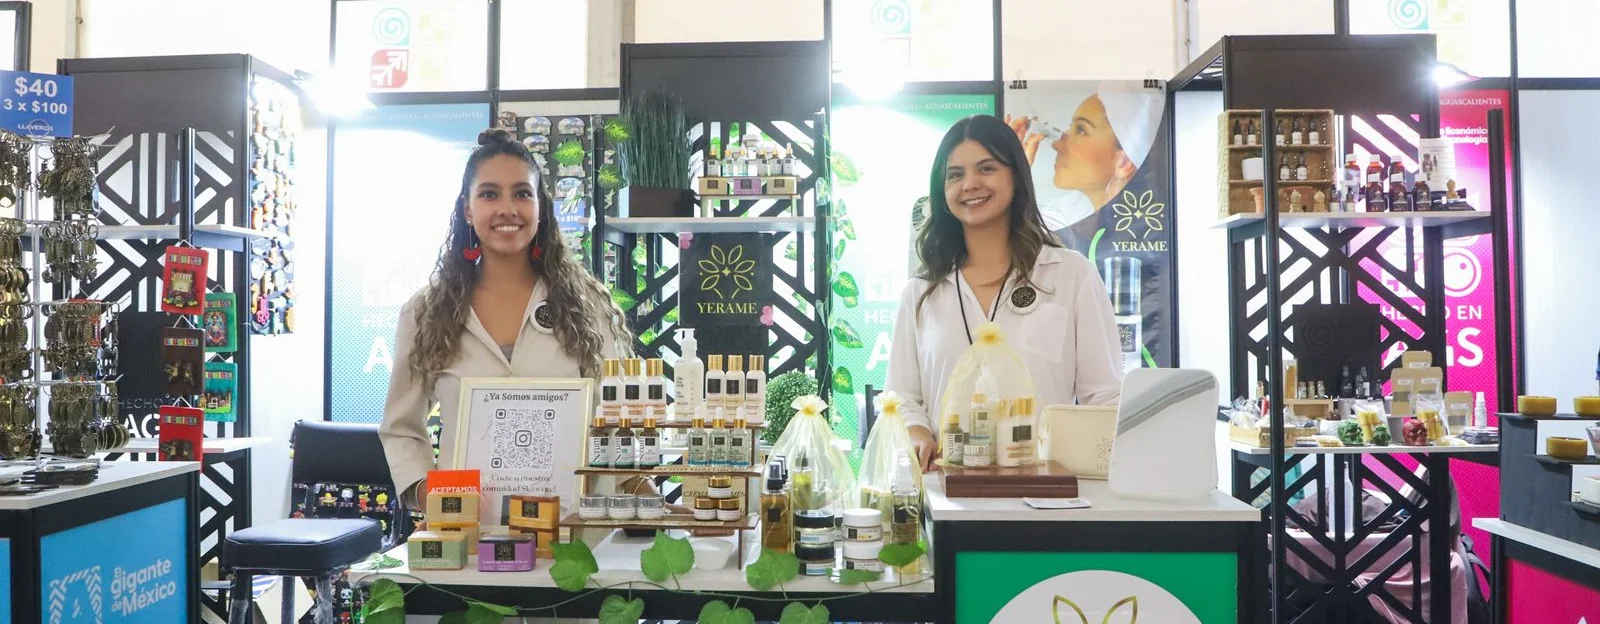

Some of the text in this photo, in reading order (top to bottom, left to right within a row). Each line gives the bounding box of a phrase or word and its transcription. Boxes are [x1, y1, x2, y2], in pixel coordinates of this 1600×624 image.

[15, 76, 58, 97] $40
[3, 98, 68, 114] 3 x $100
[925, 101, 988, 110] AGUASCALIENTES
[17, 123, 54, 131] LLAVEROS
[1112, 240, 1168, 252] YERAME
[697, 302, 757, 314] YERAME
[1457, 305, 1482, 320] EN
[118, 398, 163, 409] HECHO
[483, 392, 569, 403] ¿Ya Somos amigos?
[430, 486, 478, 494] ACEPTAMOS
[111, 559, 172, 600] gigante
[112, 580, 176, 616] de México
